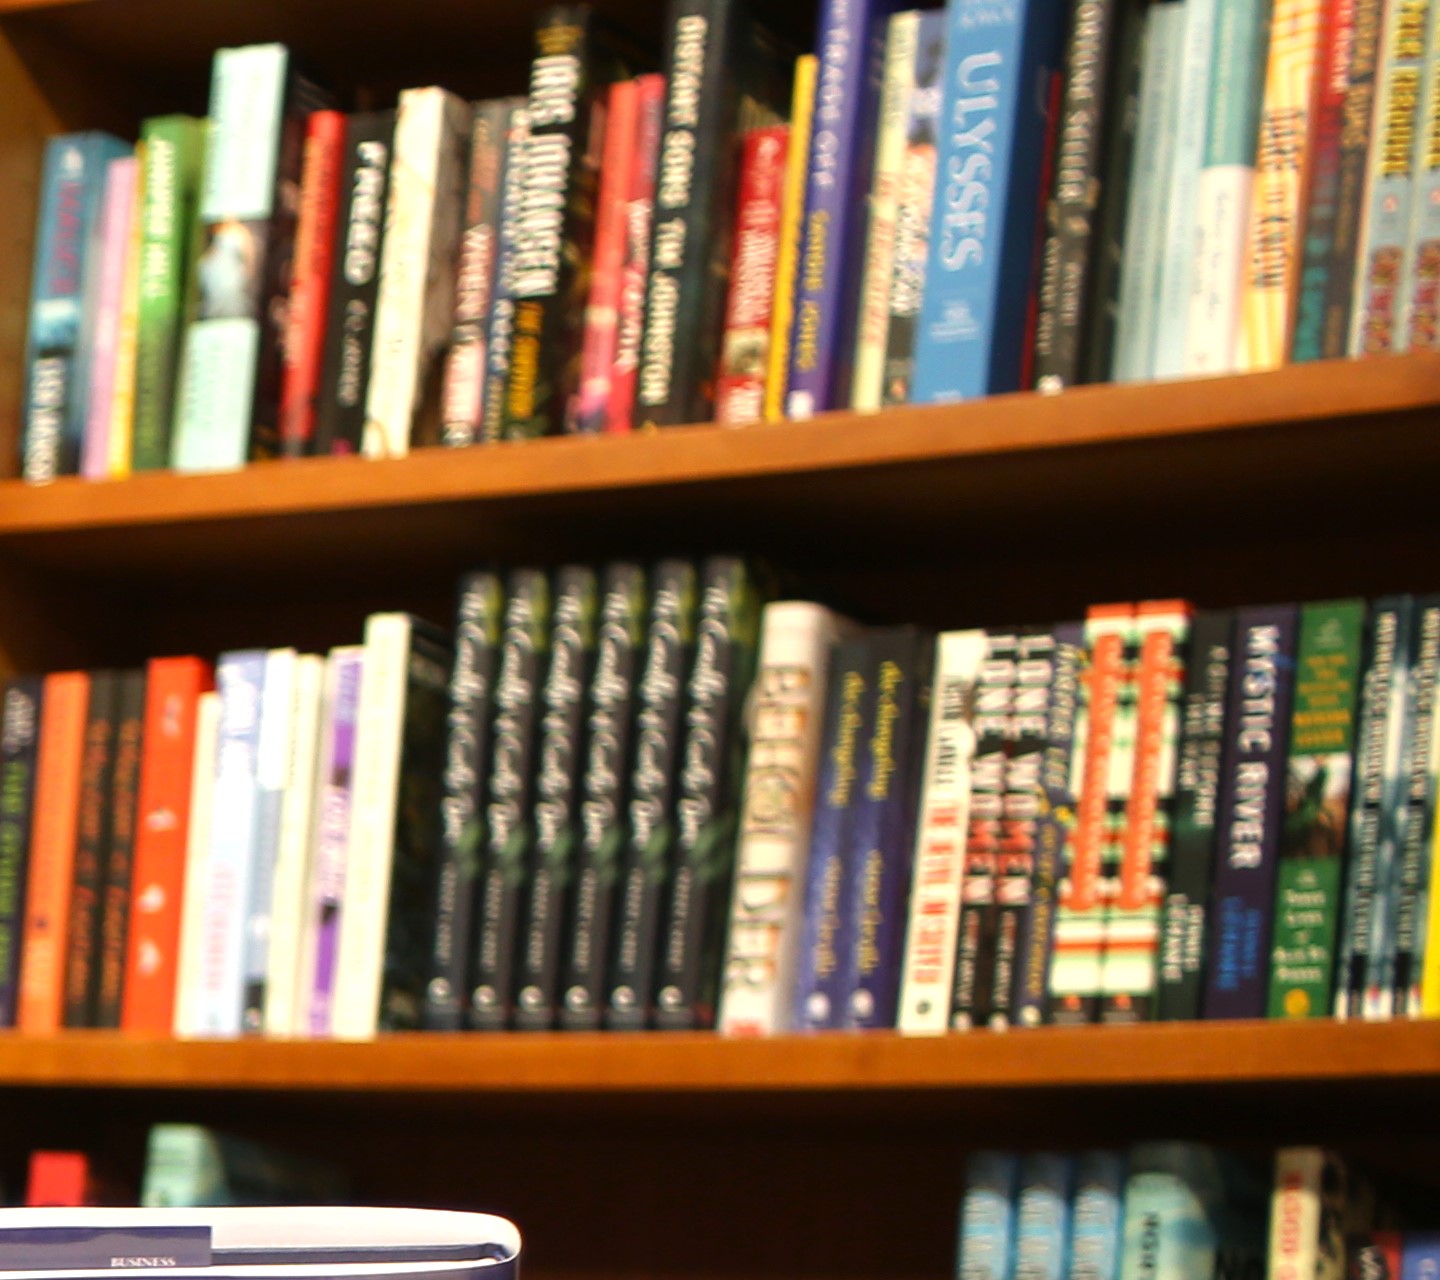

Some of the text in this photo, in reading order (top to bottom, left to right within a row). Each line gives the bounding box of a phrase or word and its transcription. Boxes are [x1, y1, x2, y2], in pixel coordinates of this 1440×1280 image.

[667, 15, 708, 125] DISTANT
[343, 141, 387, 285] FREED
[510, 133, 571, 299] JOHANSEN
[659, 130, 696, 207] SONS
[939, 50, 1003, 272] ULYSSES
[962, 635, 1017, 906] LONE WOMEN
[997, 635, 1055, 906] LONE WOMEN
[1229, 624, 1279, 868] MYSTIC RIVER
[110, 1257, 176, 1268] BUSINESS
